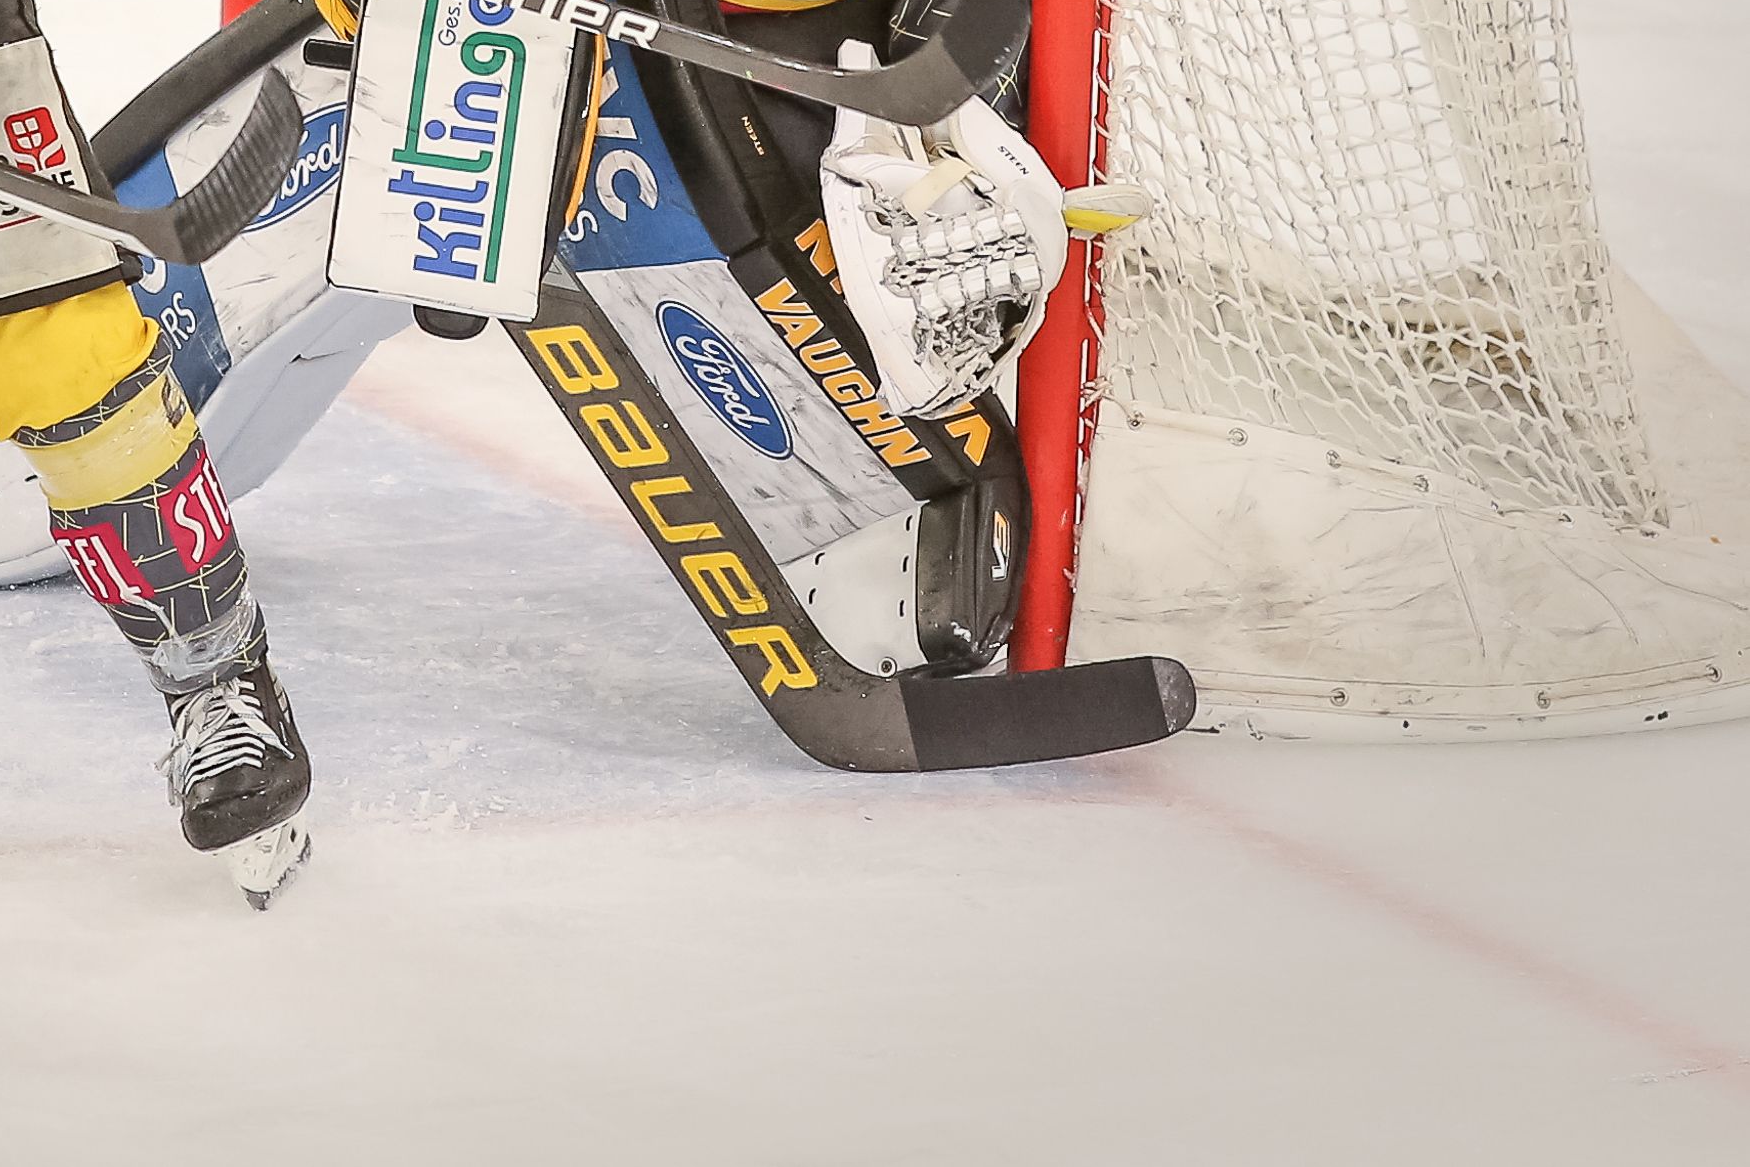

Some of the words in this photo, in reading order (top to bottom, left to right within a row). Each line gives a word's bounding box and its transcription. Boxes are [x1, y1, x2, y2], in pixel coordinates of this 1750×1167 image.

[675, 335, 771, 430] Ford
[754, 276, 934, 469] VAUGHN
[525, 324, 820, 699] BAUER
